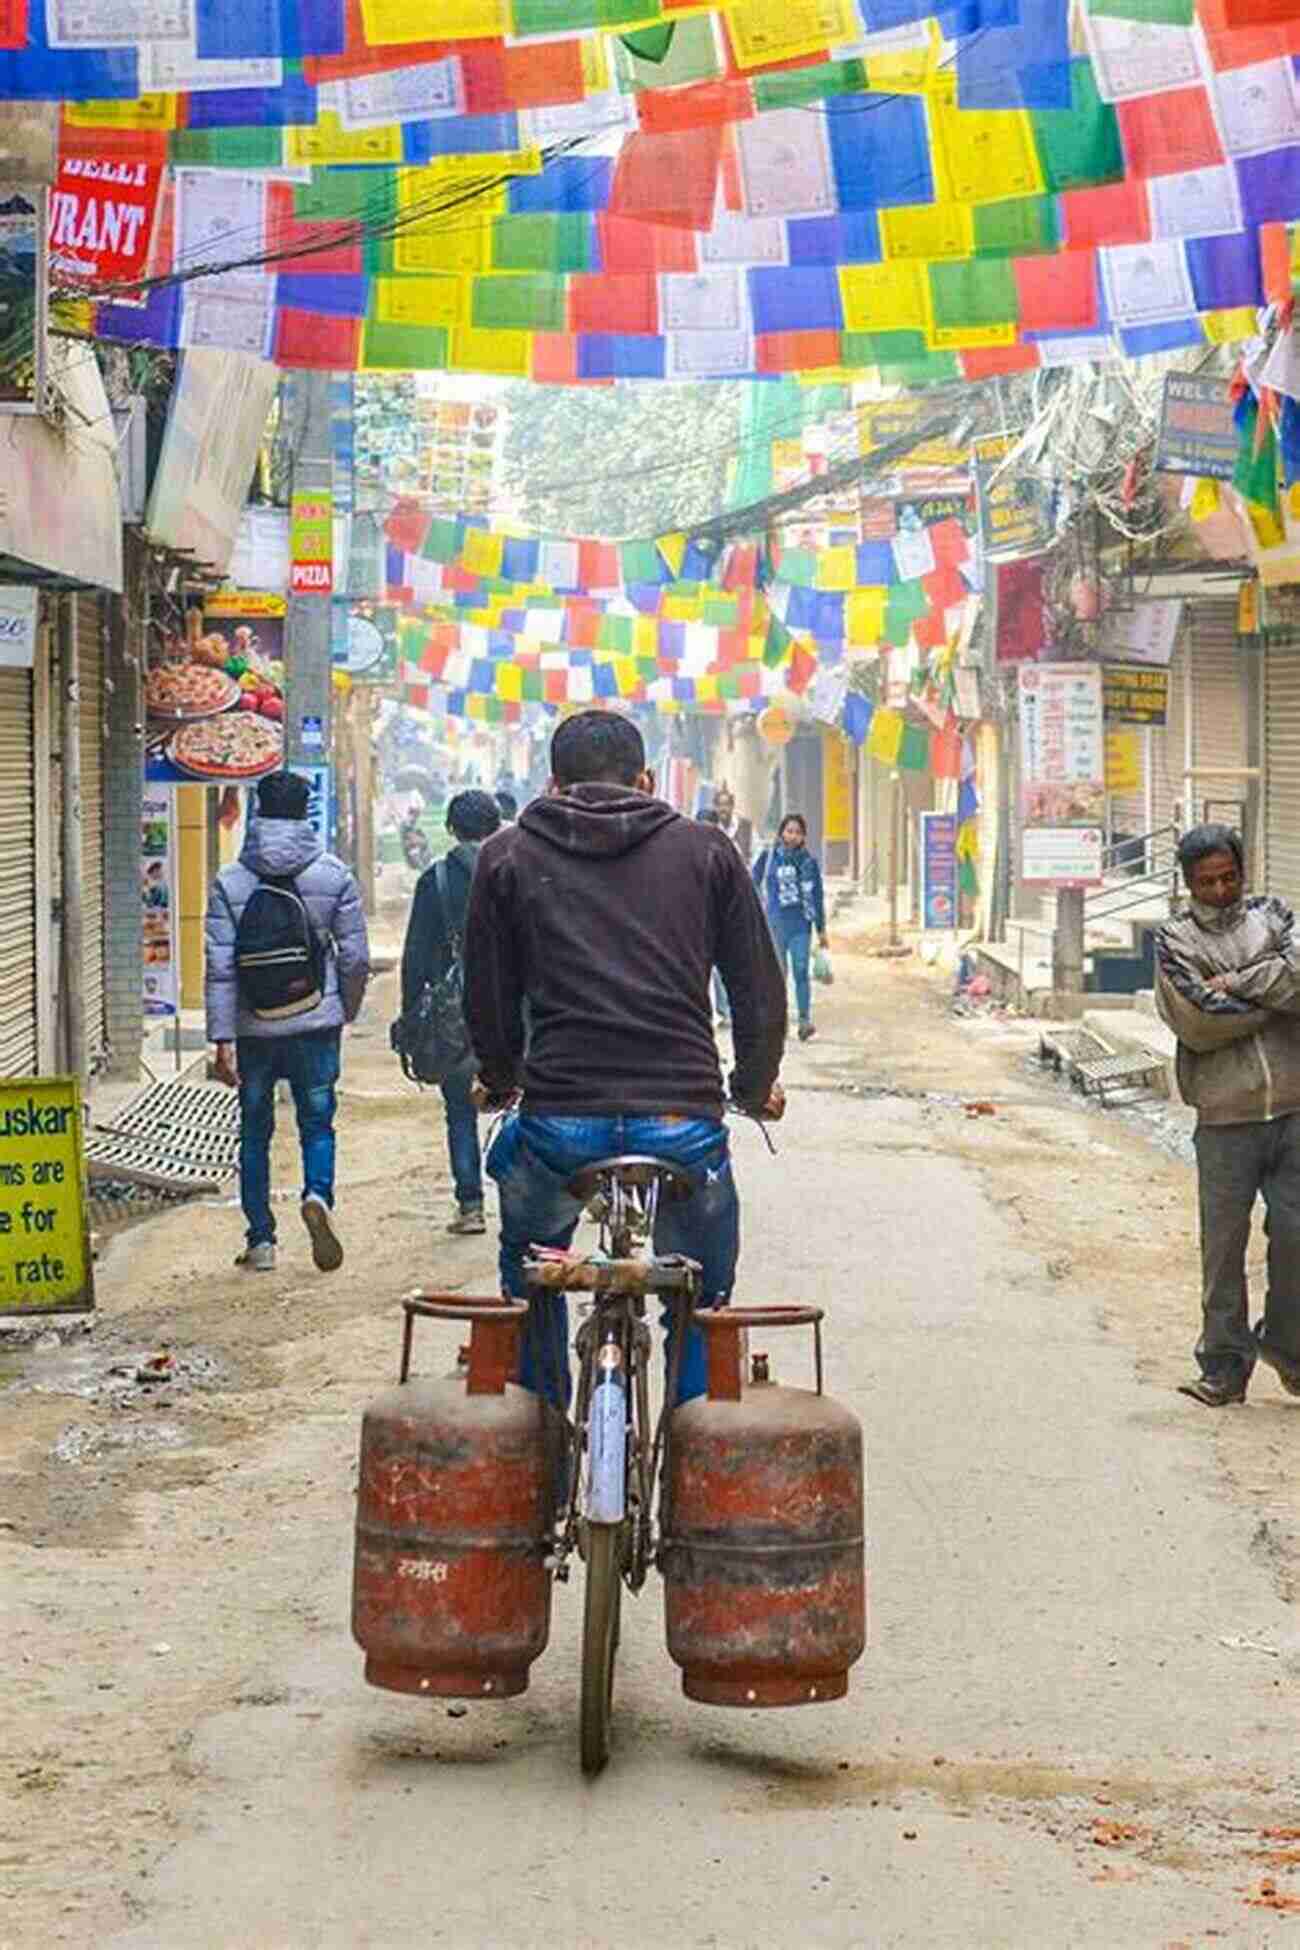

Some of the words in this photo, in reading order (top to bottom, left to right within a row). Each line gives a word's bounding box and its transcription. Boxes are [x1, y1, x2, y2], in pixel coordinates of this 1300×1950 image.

[293, 565, 331, 586] PIZZA
[32, 1161, 65, 1184] are
[21, 1200, 57, 1234] for
[15, 1253, 64, 1284] rate
